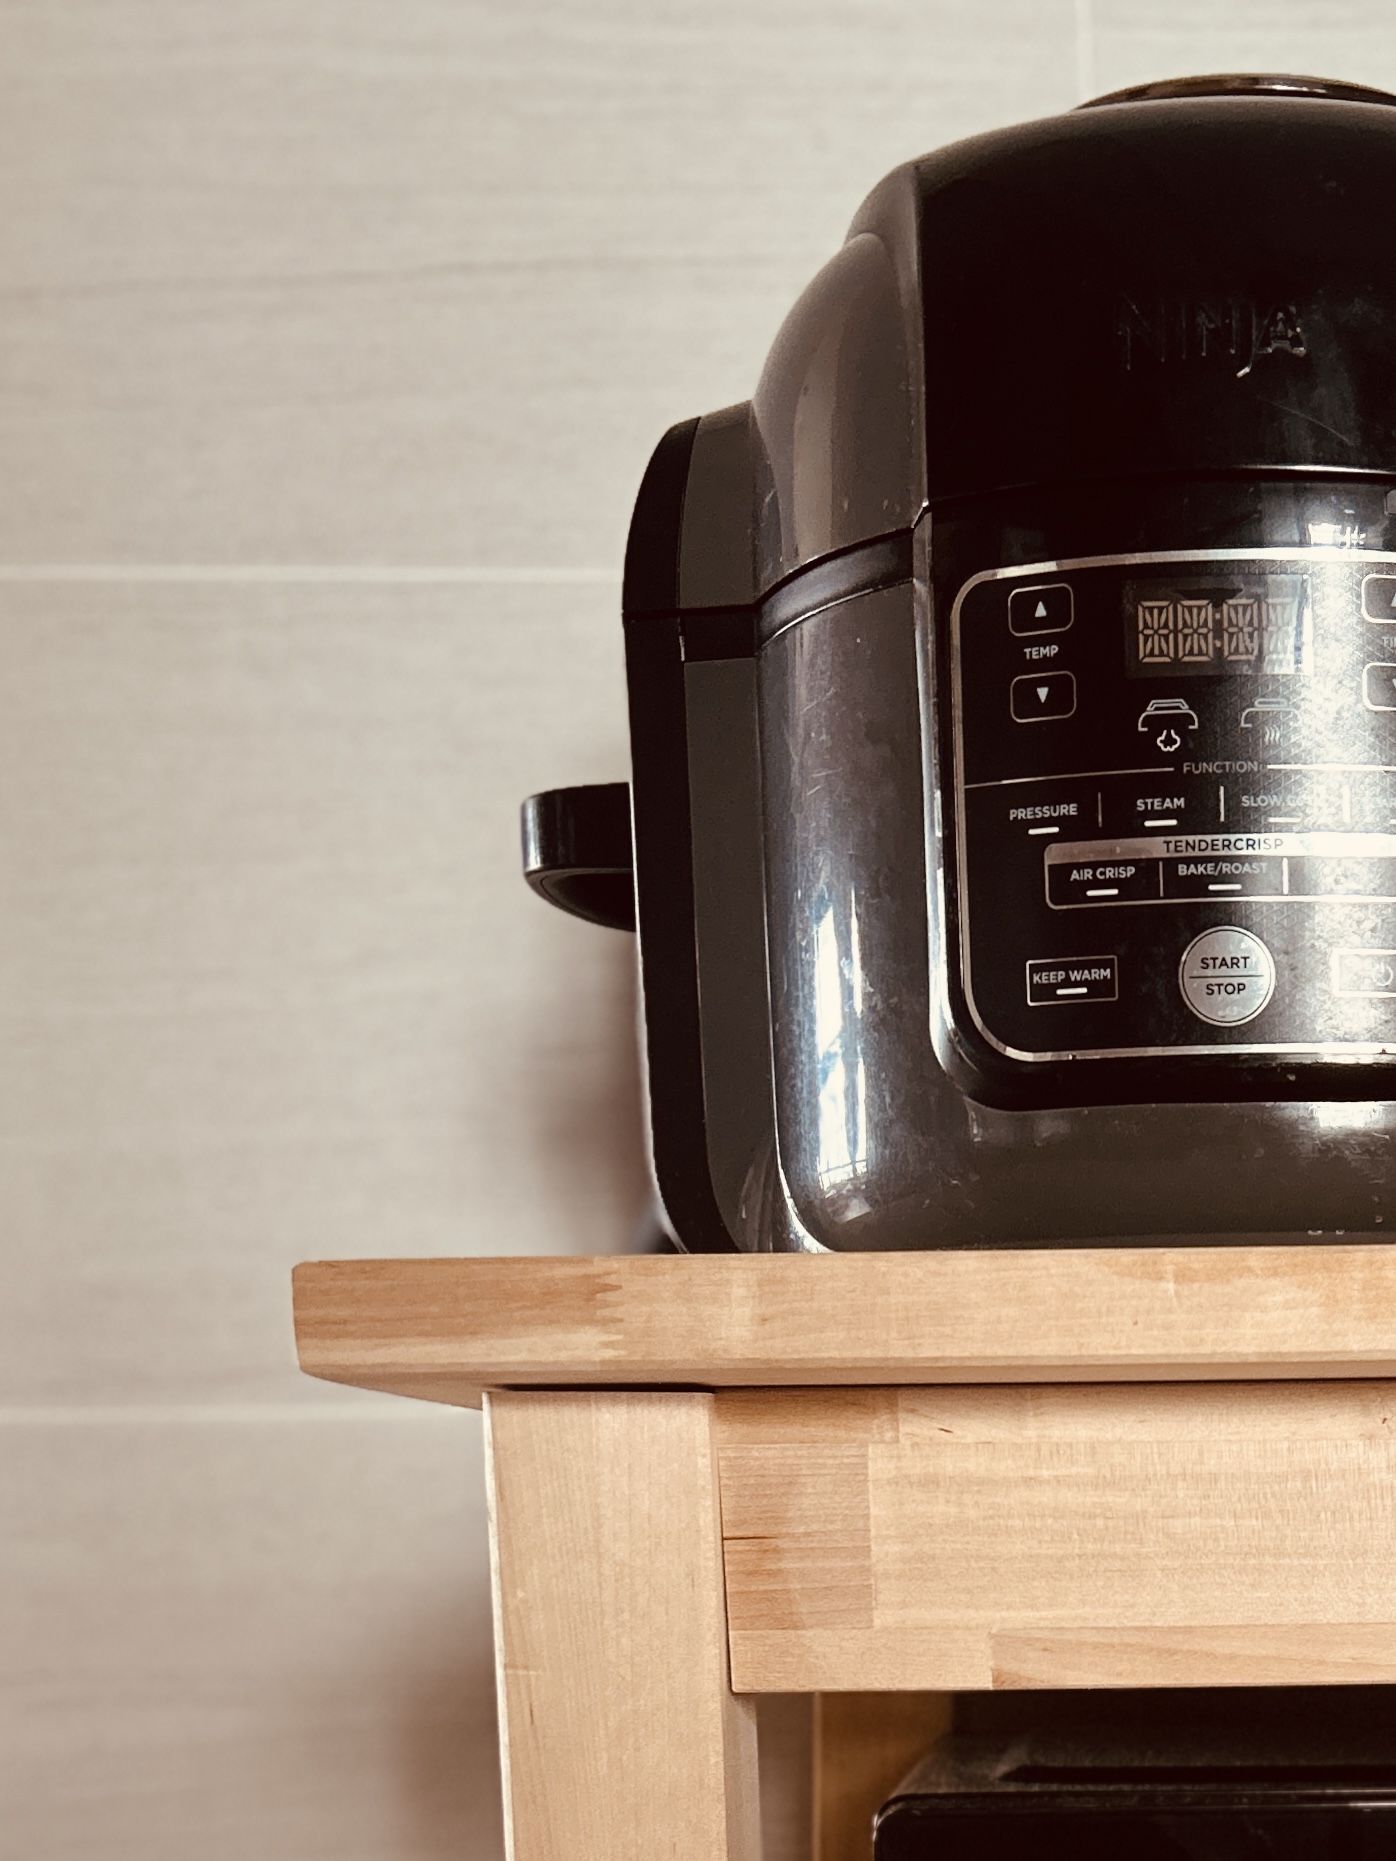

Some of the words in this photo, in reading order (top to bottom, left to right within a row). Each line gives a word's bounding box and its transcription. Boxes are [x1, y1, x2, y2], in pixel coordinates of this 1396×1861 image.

[1023, 645, 1059, 660] TEMP
[1182, 760, 1259, 775] FUNCTION
[1136, 797, 1185, 812] STEAM
[1241, 794, 1283, 808] SLOW
[1009, 803, 1078, 821] PRESSURE
[1163, 838, 1284, 854] TENDERCRISP
[1070, 868, 1093, 882] AIR
[1096, 866, 1136, 880] CRISP
[1177, 862, 1268, 877] BAKE/ROAST
[1200, 956, 1250, 970] START
[1033, 970, 1065, 985] KEEP
[1069, 967, 1111, 982] WARM
[1205, 983, 1246, 996] STOP
